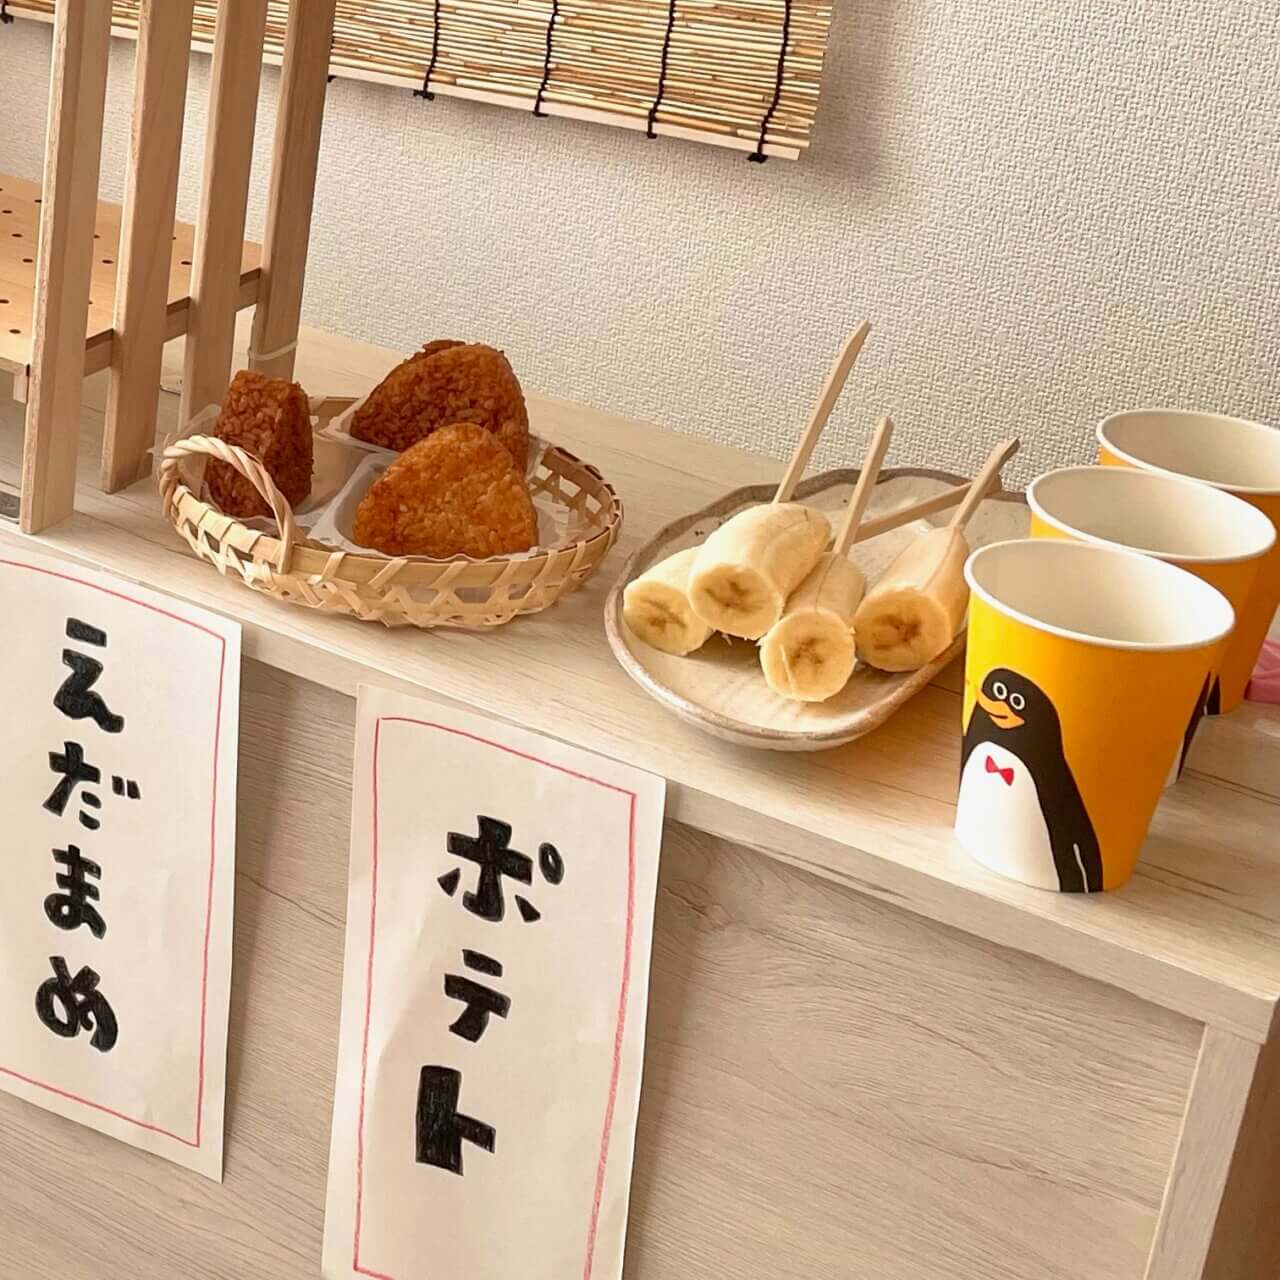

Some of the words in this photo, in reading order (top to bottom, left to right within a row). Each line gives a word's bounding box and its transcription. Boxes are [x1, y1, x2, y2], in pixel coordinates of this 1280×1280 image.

[35, 617, 141, 1053] えだまめ
[415, 814, 565, 1177] ポテト
